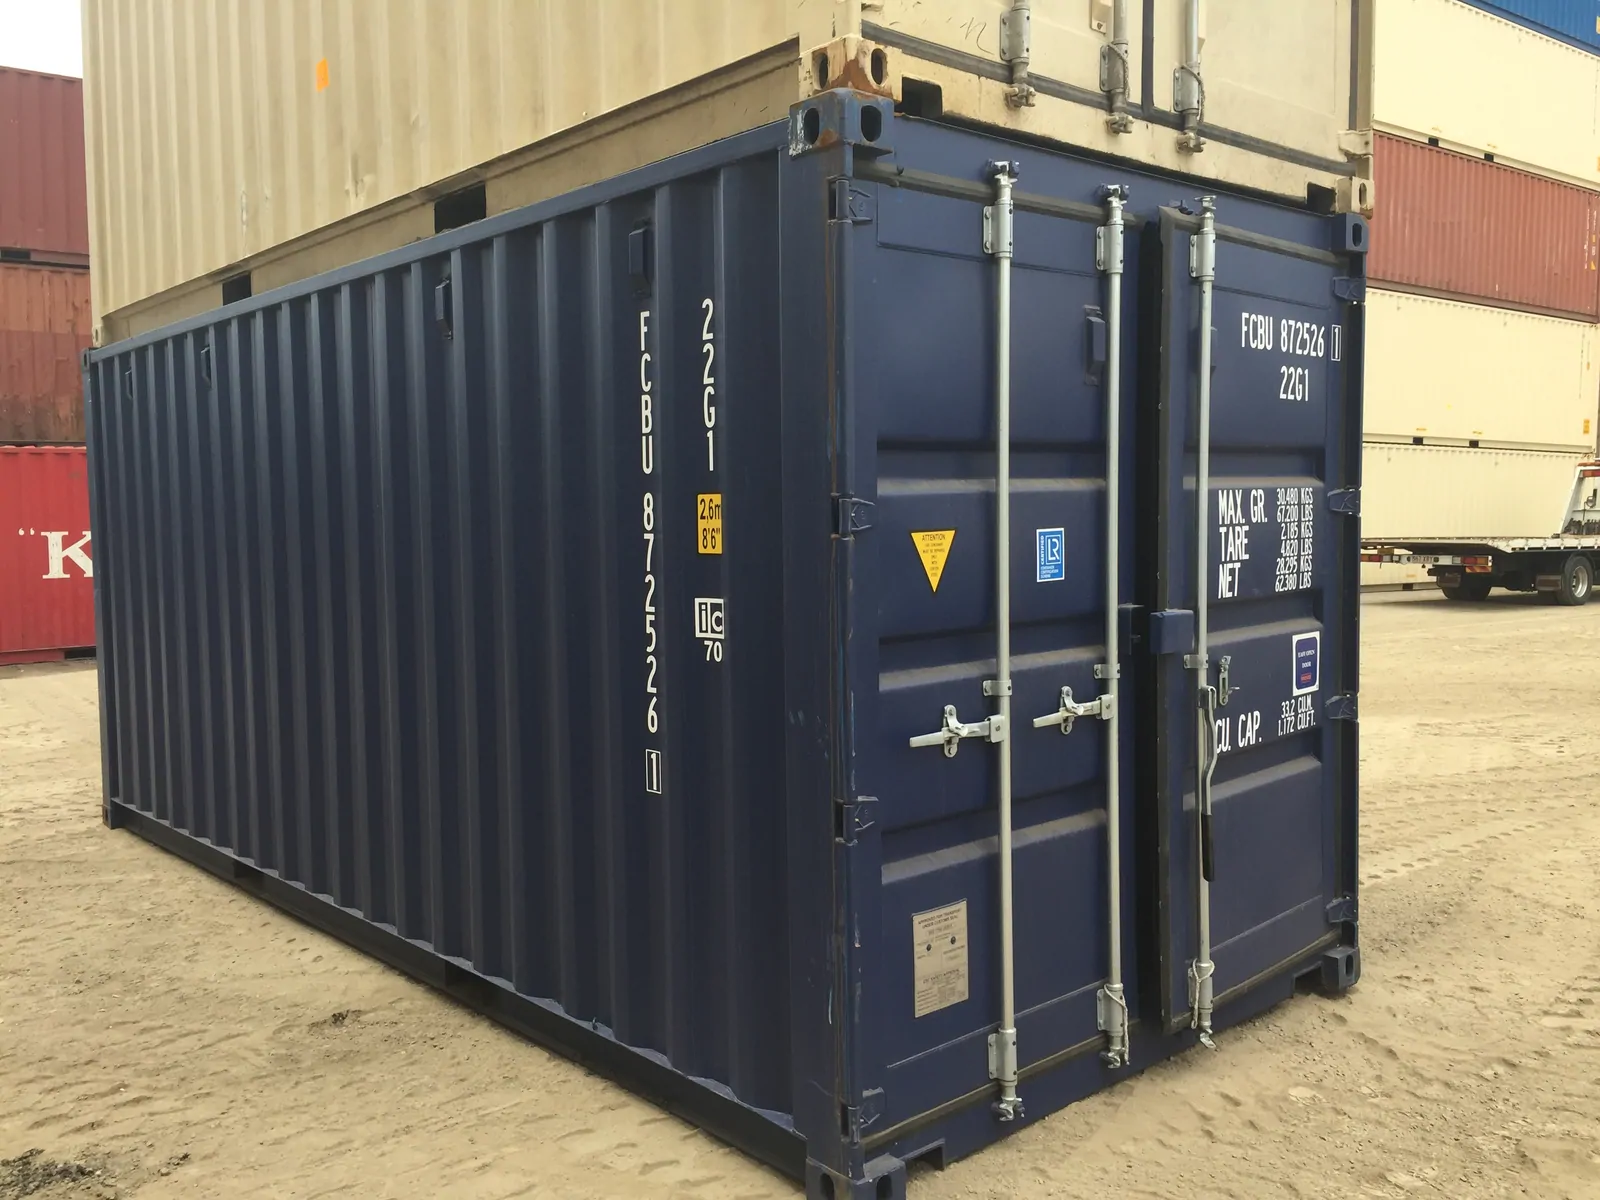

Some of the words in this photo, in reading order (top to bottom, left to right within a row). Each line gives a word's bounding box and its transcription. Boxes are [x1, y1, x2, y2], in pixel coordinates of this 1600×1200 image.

[1241, 312, 1273, 350] FCBU
[1280, 318, 1325, 358] 872526
[640, 310, 654, 474] FCBU
[702, 298, 716, 472] 22G1
[1280, 366, 1308, 402] 22G1
[1218, 489, 1246, 525] MAX.
[1250, 489, 1268, 524] GR.
[1276, 488, 1298, 505] 30.480
[1300, 487, 1313, 504] KGS
[1276, 506, 1298, 523] 67.200
[1301, 504, 1313, 521] LBS
[922, 533, 946, 542] ATTENTION
[1048, 538, 1060, 560] LR
[1219, 525, 1250, 562] TARE
[1280, 523, 1298, 540] 2.185
[1300, 522, 1313, 538] KGS
[1280, 540, 1298, 557] 4.820
[1300, 538, 1312, 555] LBS
[1218, 562, 1241, 599] NET
[1276, 558, 1298, 575] 28.295
[1300, 555, 1312, 572] KGS
[1275, 574, 1297, 592] 62.380
[1299, 572, 1312, 590] LBS
[643, 492, 658, 734] 872526
[704, 640, 722, 662] 70
[1215, 717, 1231, 754] CU.
[1238, 710, 1262, 748] CAP.
[1281, 699, 1295, 718] 33.2
[1278, 716, 1294, 736] 1.172
